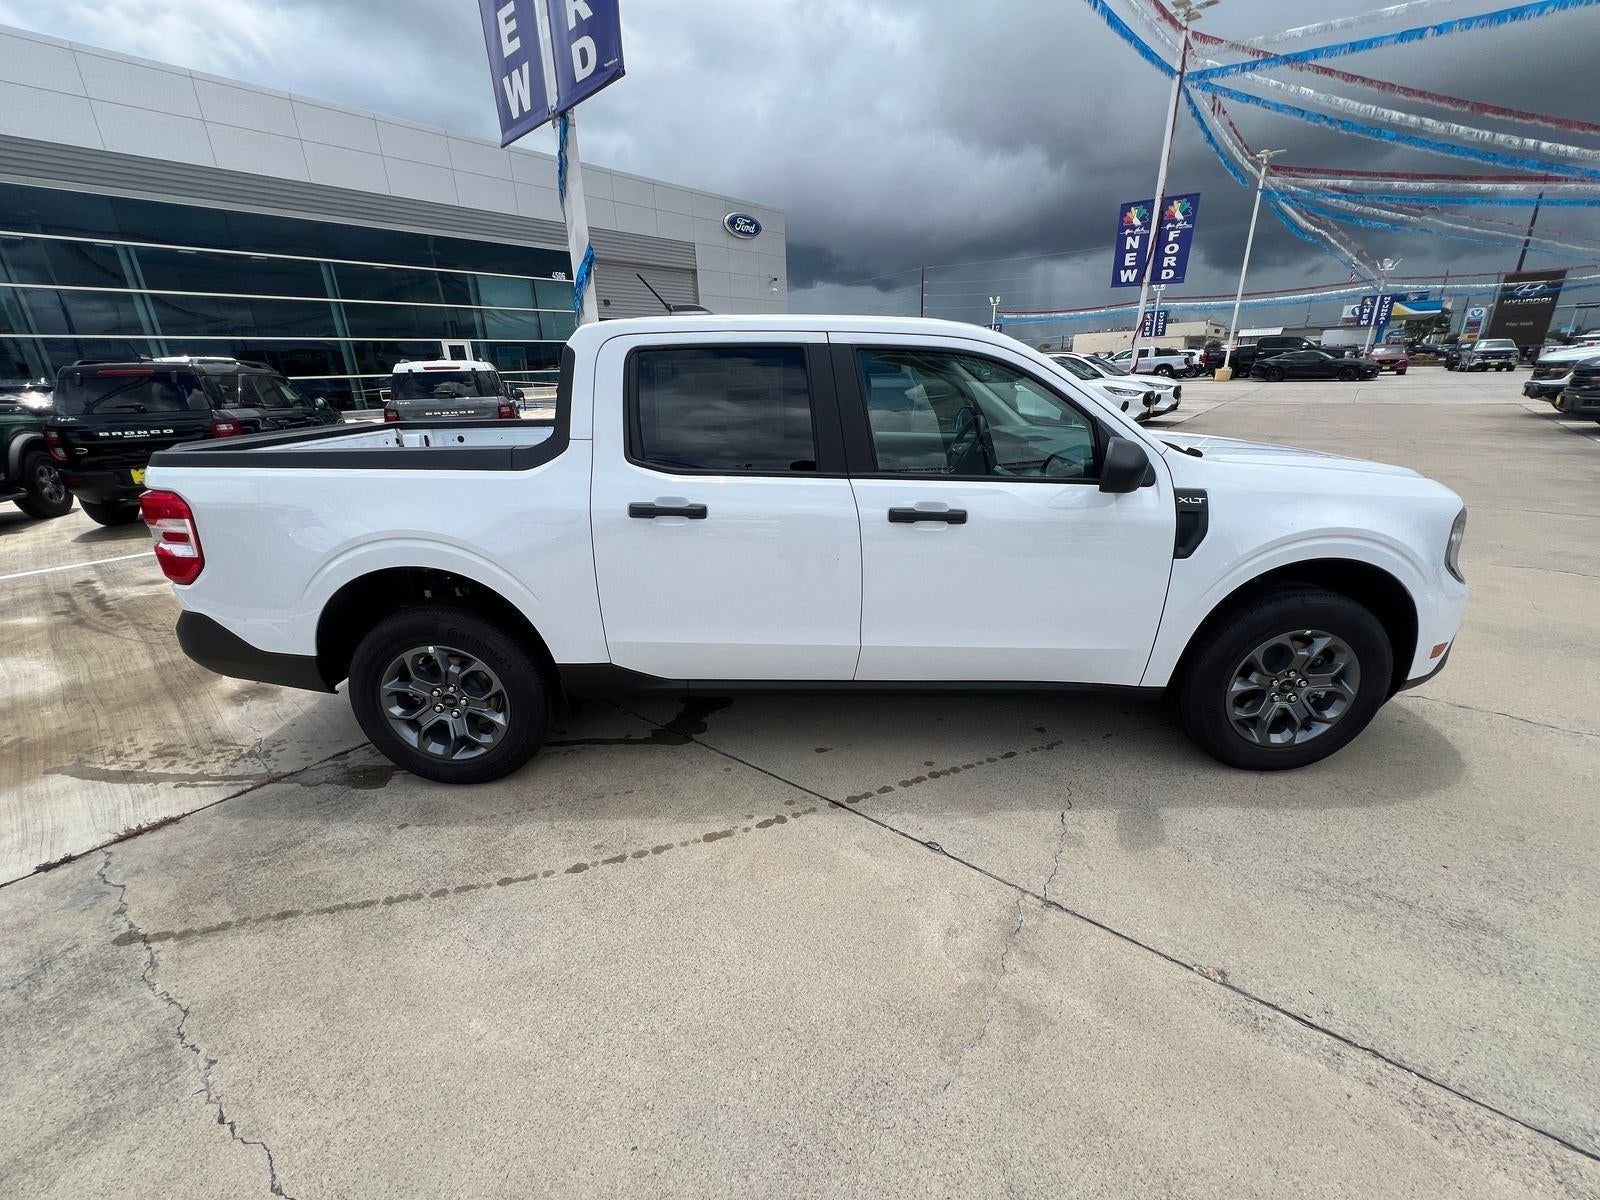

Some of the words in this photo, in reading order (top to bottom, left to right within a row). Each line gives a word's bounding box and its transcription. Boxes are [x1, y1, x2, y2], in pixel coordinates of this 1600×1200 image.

[734, 217, 756, 233] Ford
[1120, 236, 1140, 283] NEW
[1161, 230, 1181, 280] FORD
[1360, 307, 1371, 326] NEW
[1379, 296, 1391, 325] HYUNDAI
[1143, 321, 1151, 337] NEW
[98, 429, 174, 437] BRONCO
[1178, 496, 1206, 504] XLT
